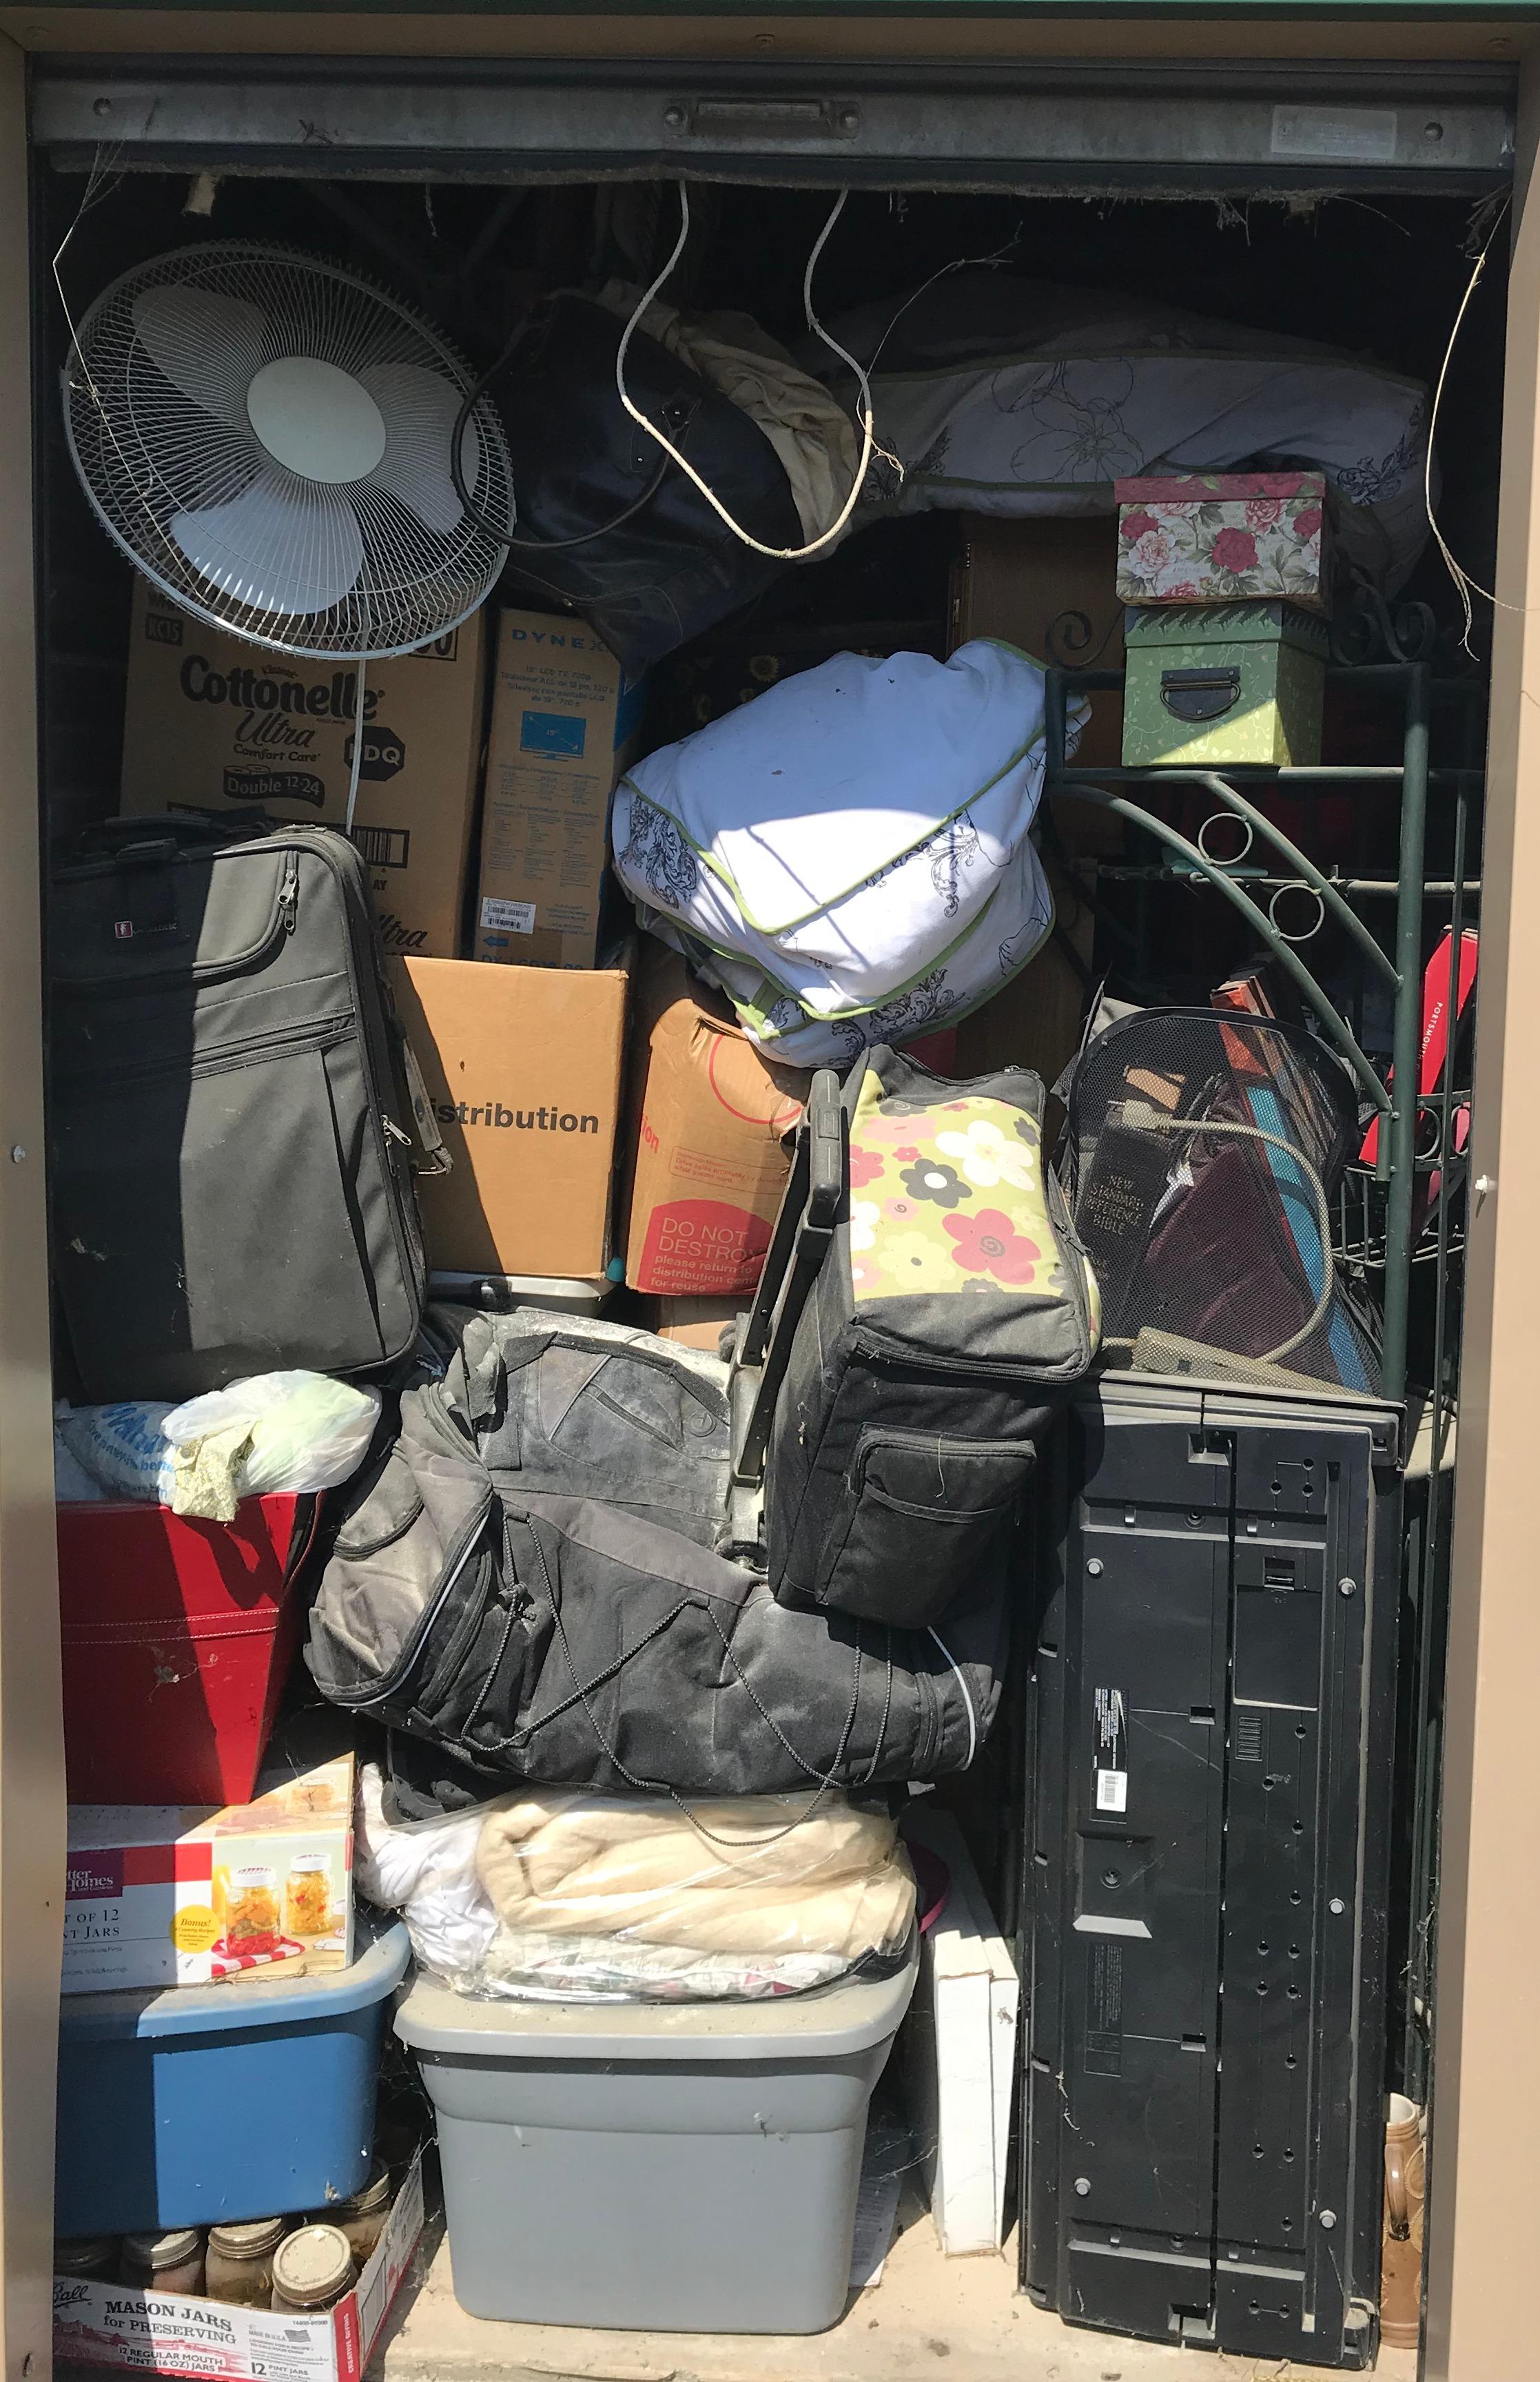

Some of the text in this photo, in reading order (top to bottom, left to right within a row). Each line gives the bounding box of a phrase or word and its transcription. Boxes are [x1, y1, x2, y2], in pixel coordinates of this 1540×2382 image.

[180, 655, 378, 721] Cottonelle
[235, 710, 317, 748] Ultra
[233, 743, 318, 762] Comfort Care
[348, 743, 401, 766] DQ
[227, 777, 282, 794] Double
[379, 914, 429, 949] ltra
[430, 1097, 599, 1134] istribution
[641, 1114, 660, 1155] ion
[661, 1216, 749, 1246] DO NOT
[658, 1235, 763, 1264] DESTROY
[654, 1254, 752, 1274] please return to
[650, 1277, 706, 1293] for reuse
[653, 1266, 758, 1285] distribution cent
[141, 1459, 174, 1473] bette
[67, 1869, 92, 1881] tter
[76, 1913, 96, 1923] OF
[103, 1909, 120, 1922] 12
[181, 1918, 212, 1927] Bonus!
[84, 1926, 120, 1940] JARS
[105, 2301, 233, 2332] MASON JARS
[343, 2312, 351, 2339] GIVING
[103, 2314, 238, 2345] for PRESERVING
[248, 2330, 264, 2338] MADE
[119, 2347, 223, 2366] 12 REGULAR MOUTH
[126, 2357, 151, 2367] PINT
[170, 2360, 189, 2370] OZ)
[191, 2362, 216, 2373] JARS
[346, 2340, 354, 2374] CREATIVE
[251, 2361, 309, 2376] 12 PINT JARS
